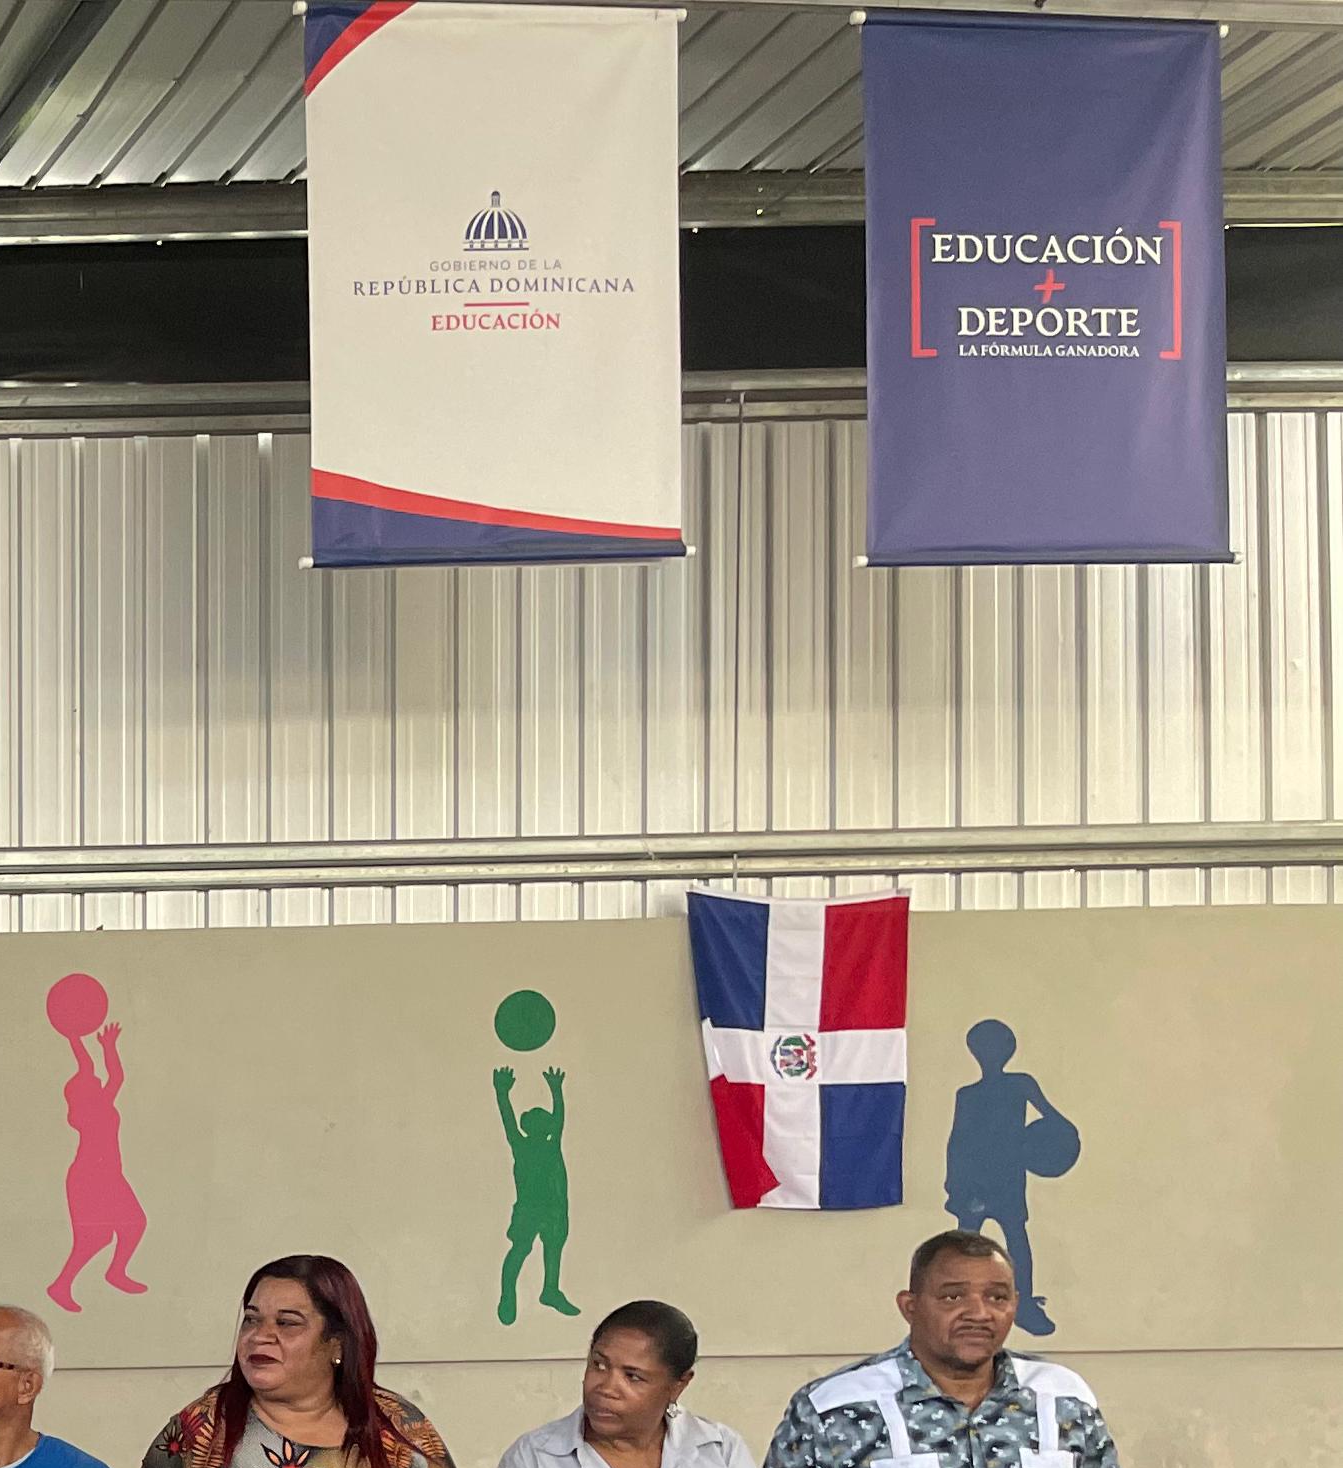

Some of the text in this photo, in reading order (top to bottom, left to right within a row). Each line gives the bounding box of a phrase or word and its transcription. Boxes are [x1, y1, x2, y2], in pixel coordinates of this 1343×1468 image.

[931, 226, 1163, 265] EDUCACIÓN
[429, 259, 562, 272] GOBIERNO DE LA
[353, 276, 635, 296] REPÚBLICA DOMINICANA
[431, 309, 562, 331] EDUCACIÓN
[957, 307, 1141, 337] DEPORTE
[959, 341, 1140, 358] LA FÓRMULA GANADORA
